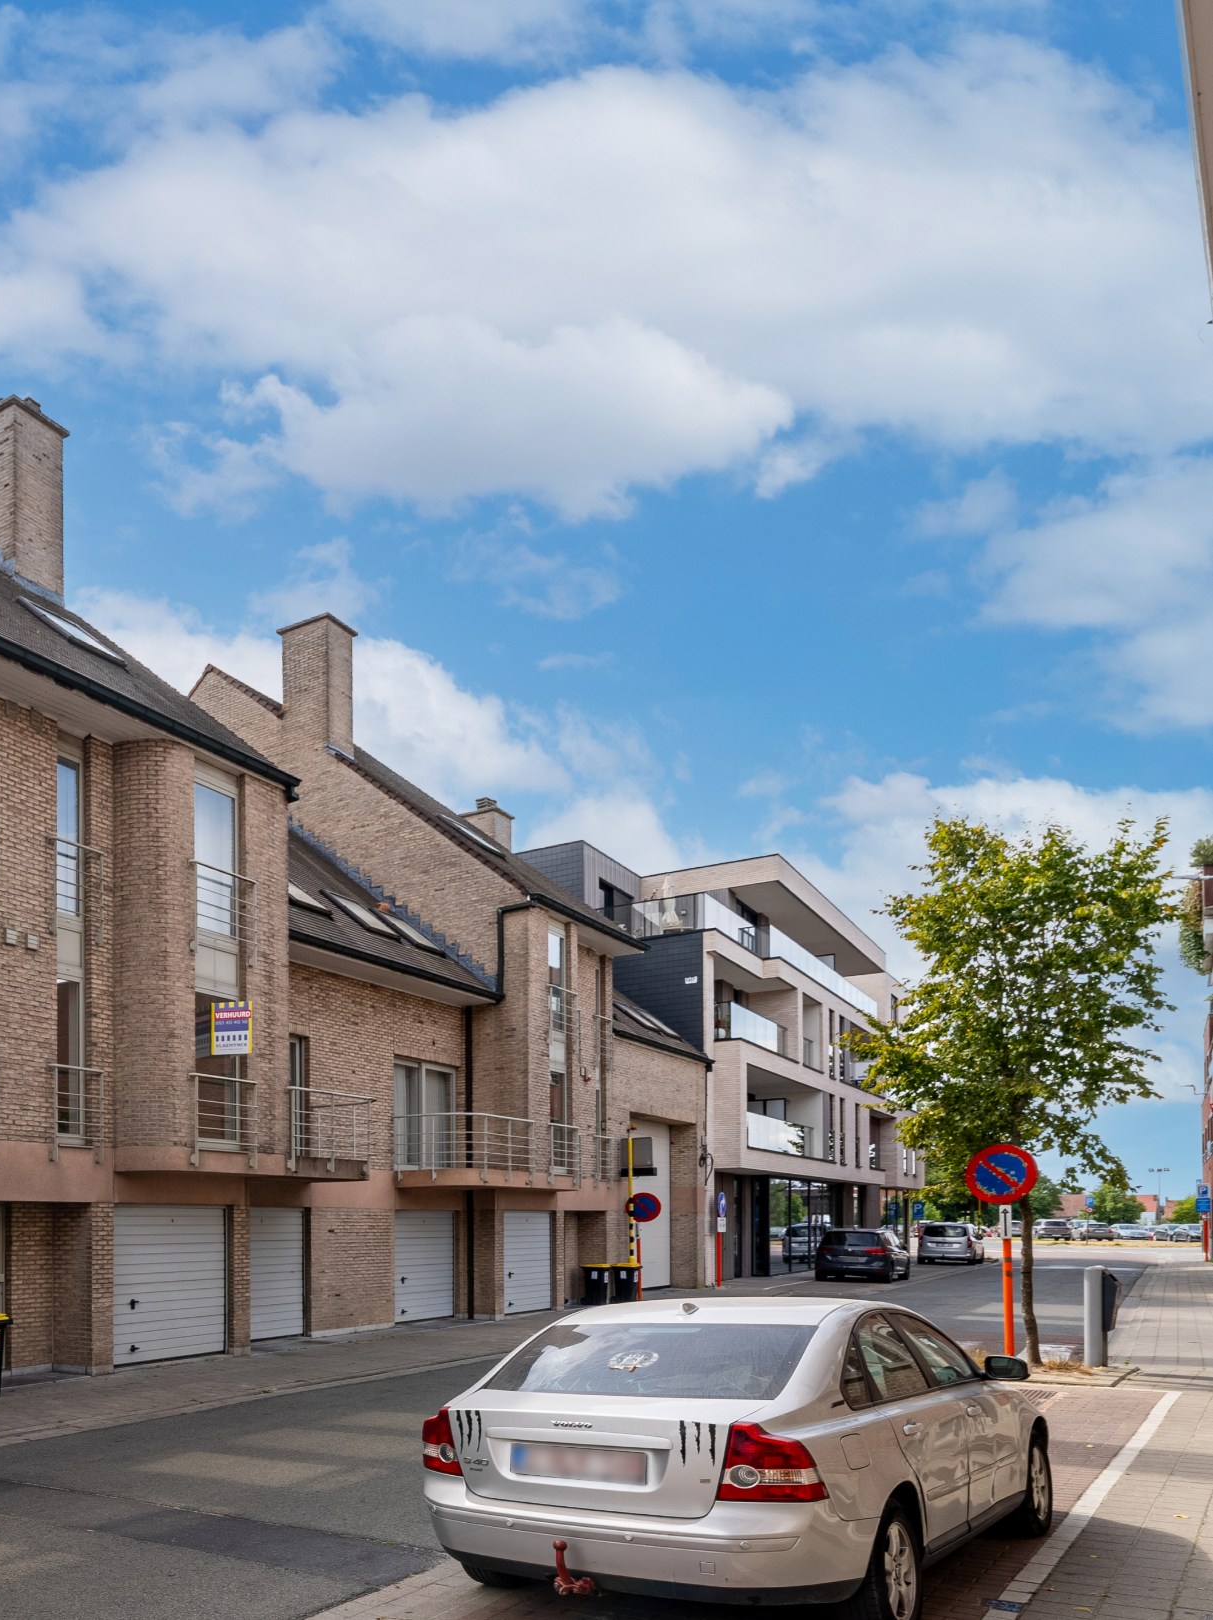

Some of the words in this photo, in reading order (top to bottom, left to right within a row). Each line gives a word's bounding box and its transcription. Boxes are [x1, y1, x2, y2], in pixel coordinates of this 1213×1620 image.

[215, 1011, 251, 1019] VERHUURD
[1086, 1197, 1093, 1206] P
[914, 1203, 923, 1213] P
[550, 1420, 593, 1429] VOLVO
